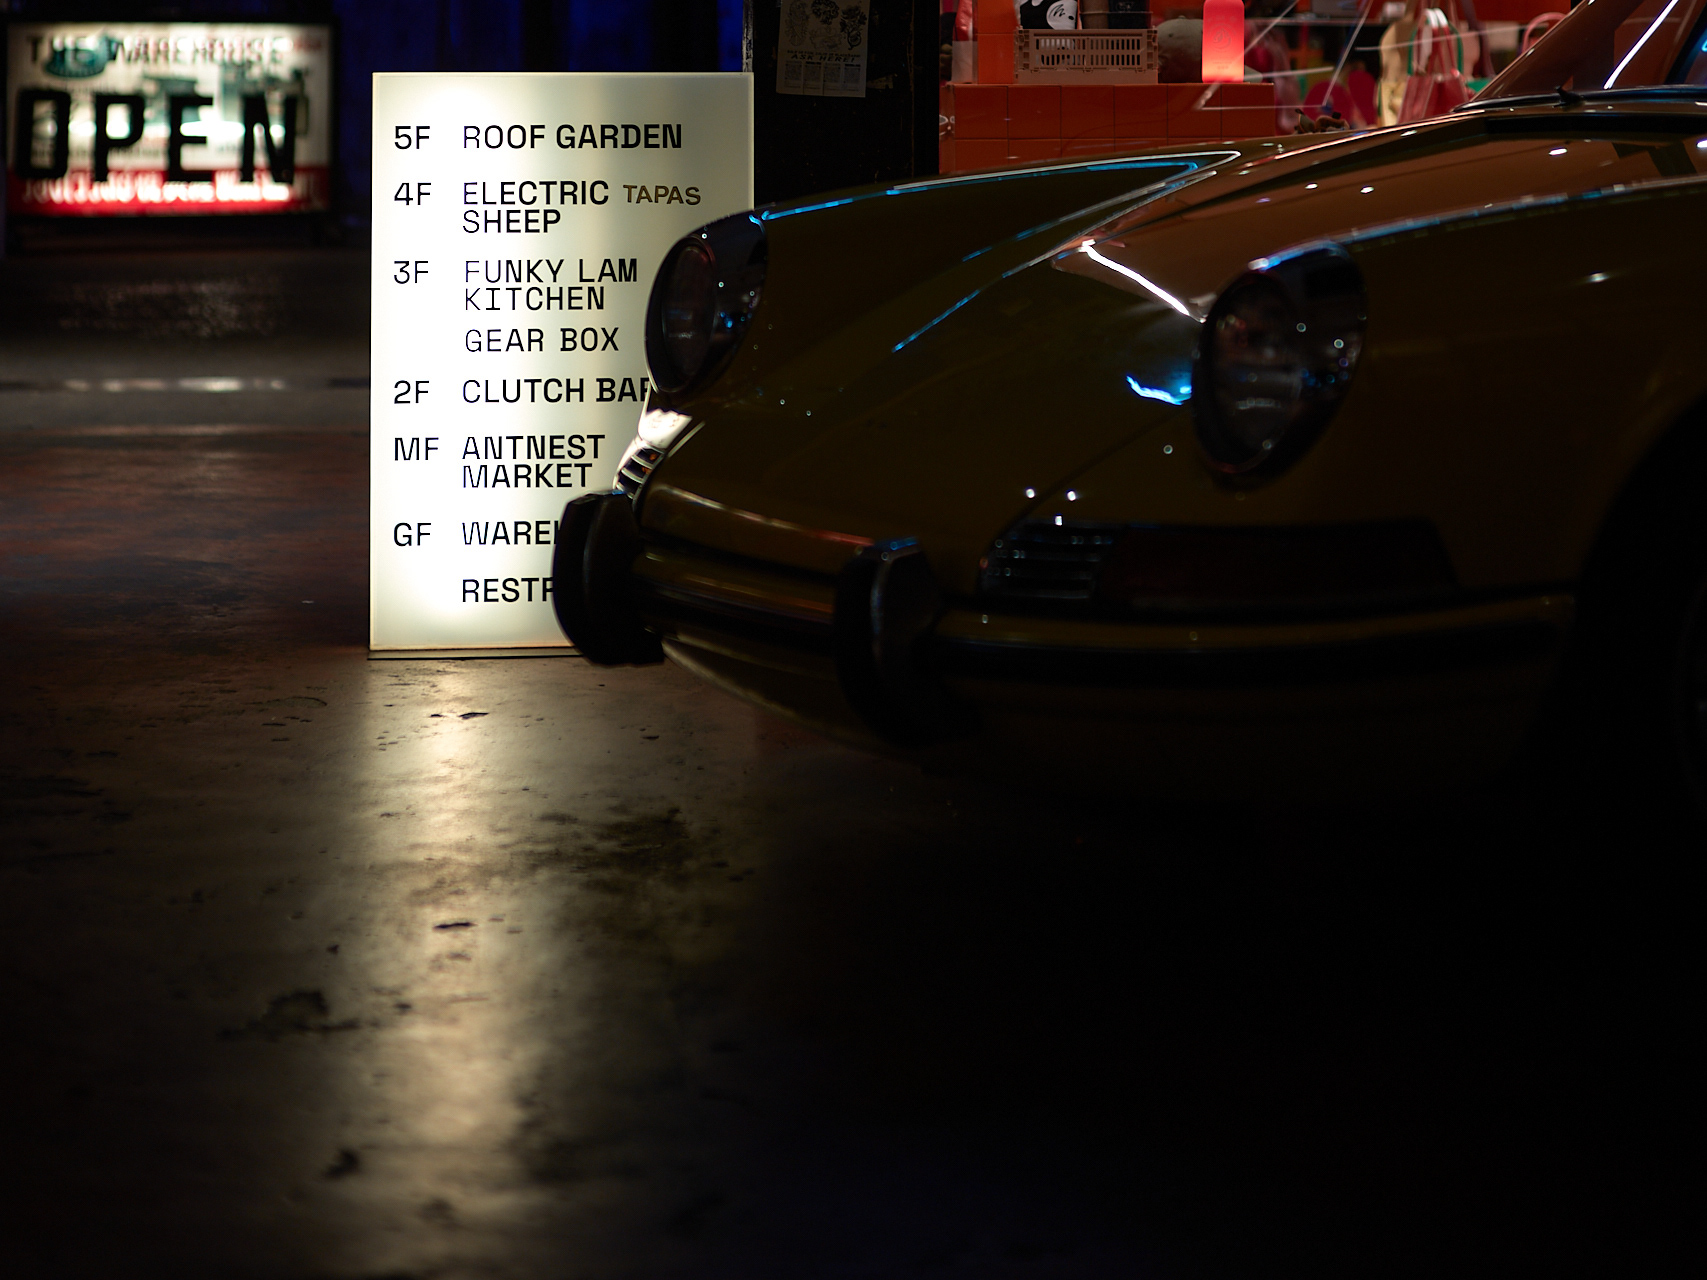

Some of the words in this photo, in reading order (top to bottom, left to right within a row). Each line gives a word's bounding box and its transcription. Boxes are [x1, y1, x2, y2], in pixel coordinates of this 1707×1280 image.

[15, 88, 298, 184] OPEN
[394, 125, 431, 150] 5F
[463, 124, 546, 150] ROOF
[555, 123, 682, 150] GARDEN
[393, 182, 432, 206] 4F
[463, 179, 610, 206] ELECTRIC
[623, 184, 702, 206] TAPAS
[462, 209, 562, 234] SHEEP
[393, 260, 429, 285] 3F
[465, 258, 565, 284] FUNKY
[578, 258, 638, 283] LAM
[465, 285, 605, 311] KITCHEN
[465, 328, 544, 353] GEAR
[559, 326, 620, 352] BOX
[393, 380, 430, 405] 2F
[463, 378, 585, 403] CLUTCH
[394, 436, 440, 462] MF
[462, 434, 606, 460] ANTNEST
[462, 463, 593, 489] MARKET
[393, 522, 432, 547] GF
[462, 521, 559, 546] WARE
